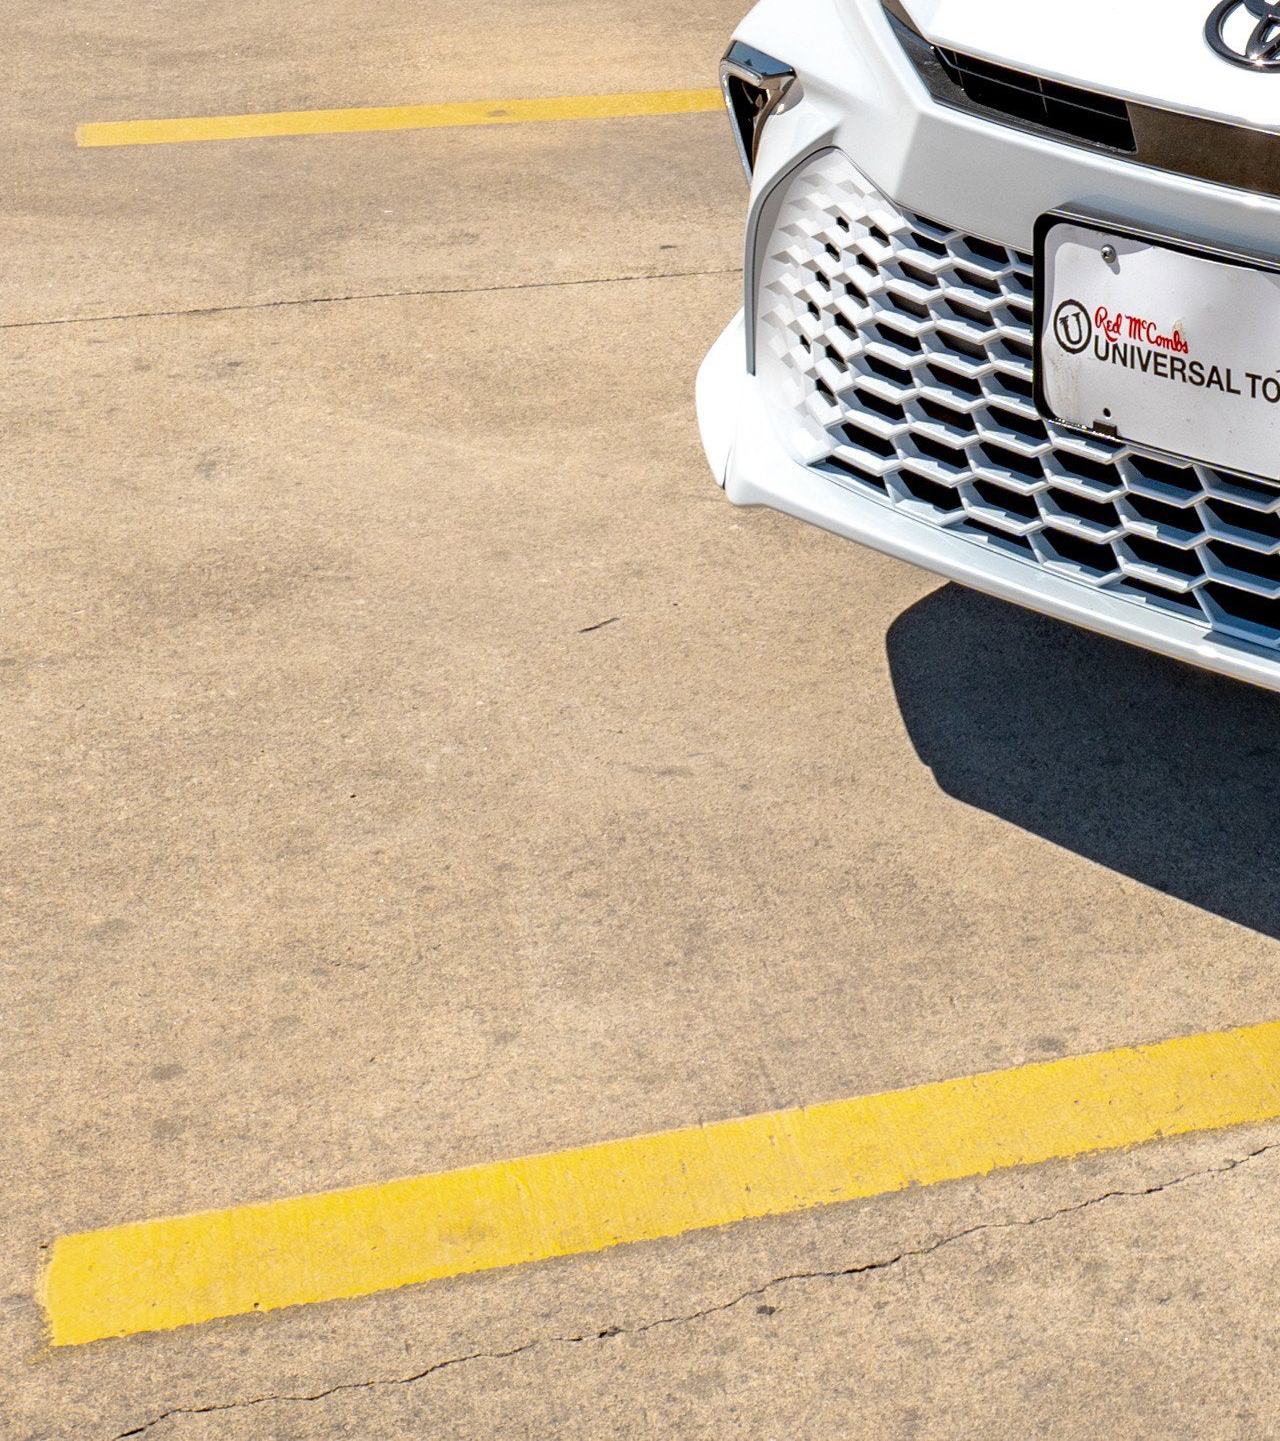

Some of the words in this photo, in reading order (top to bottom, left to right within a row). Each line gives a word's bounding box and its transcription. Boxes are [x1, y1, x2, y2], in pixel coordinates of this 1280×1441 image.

[1094, 306, 1122, 343] Red
[1126, 315, 1189, 354] McCombs
[1094, 334, 1241, 395] UNIVERSAL
